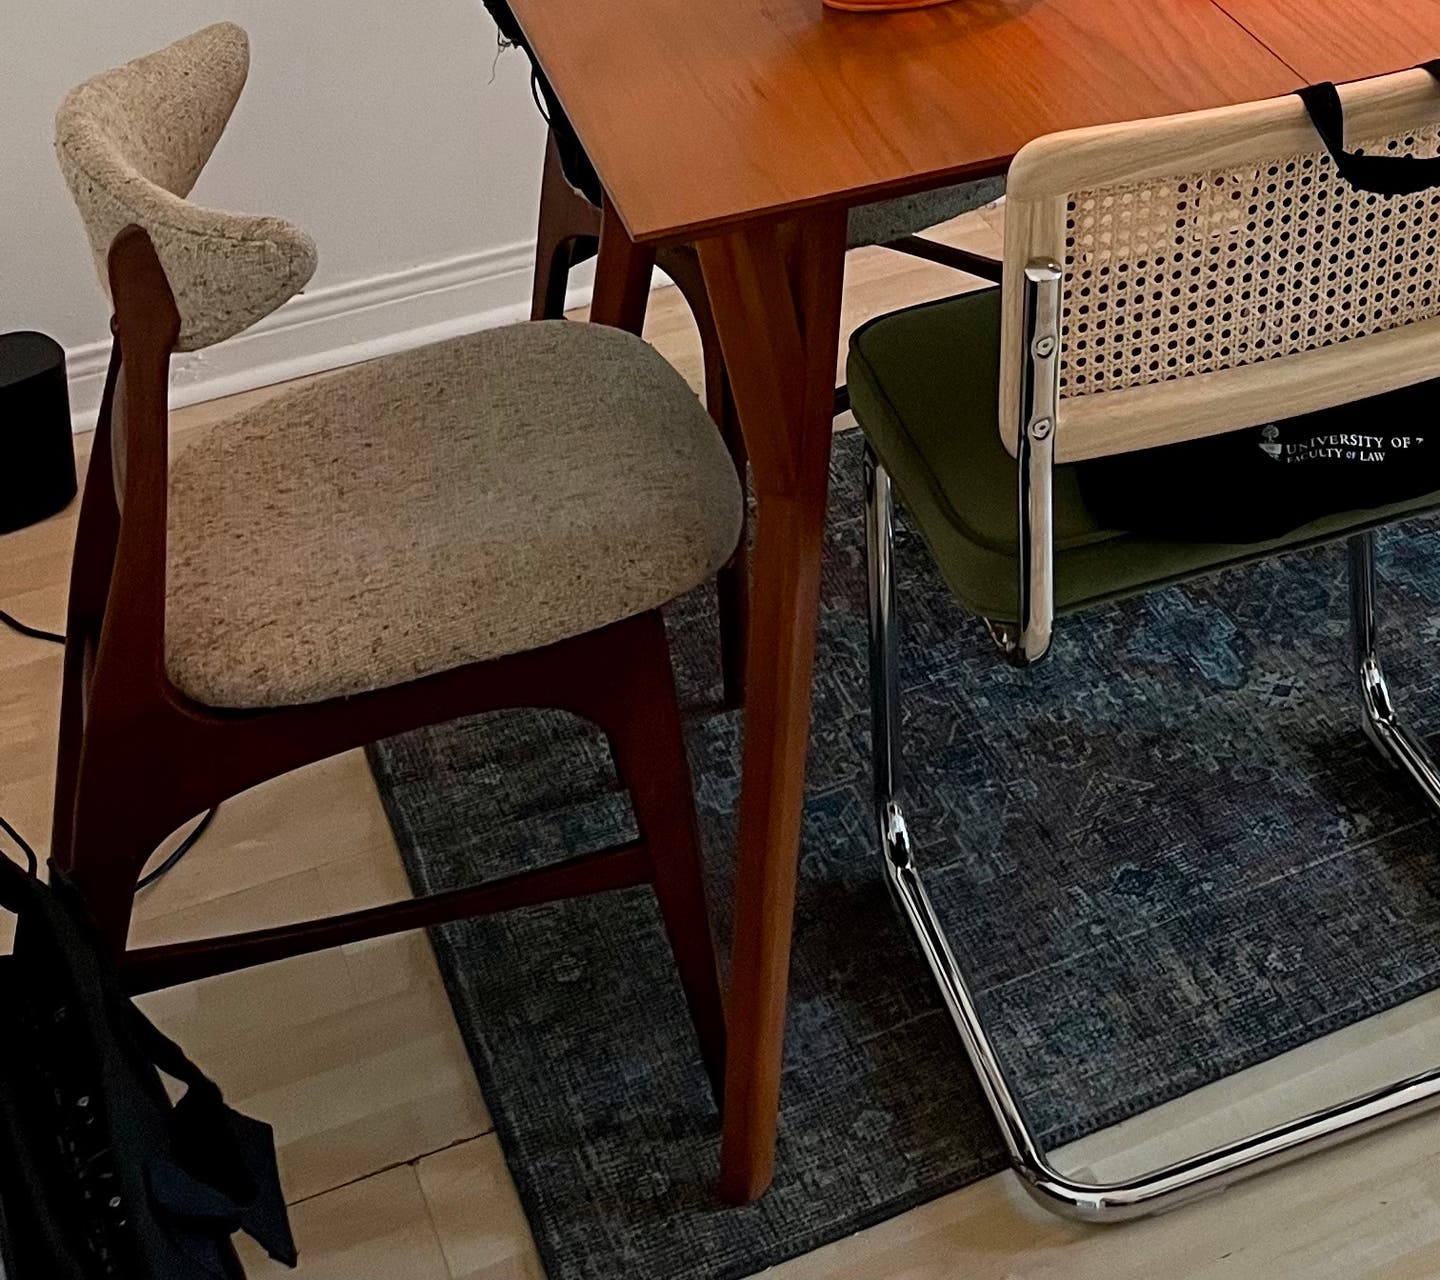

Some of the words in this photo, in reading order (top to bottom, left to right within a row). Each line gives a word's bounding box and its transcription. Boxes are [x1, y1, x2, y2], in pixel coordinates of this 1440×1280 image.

[1286, 433, 1384, 455] UNIVERSITY
[1390, 436, 1412, 449] OF
[1286, 447, 1343, 464] FACULTY
[1359, 450, 1386, 462] LAW
